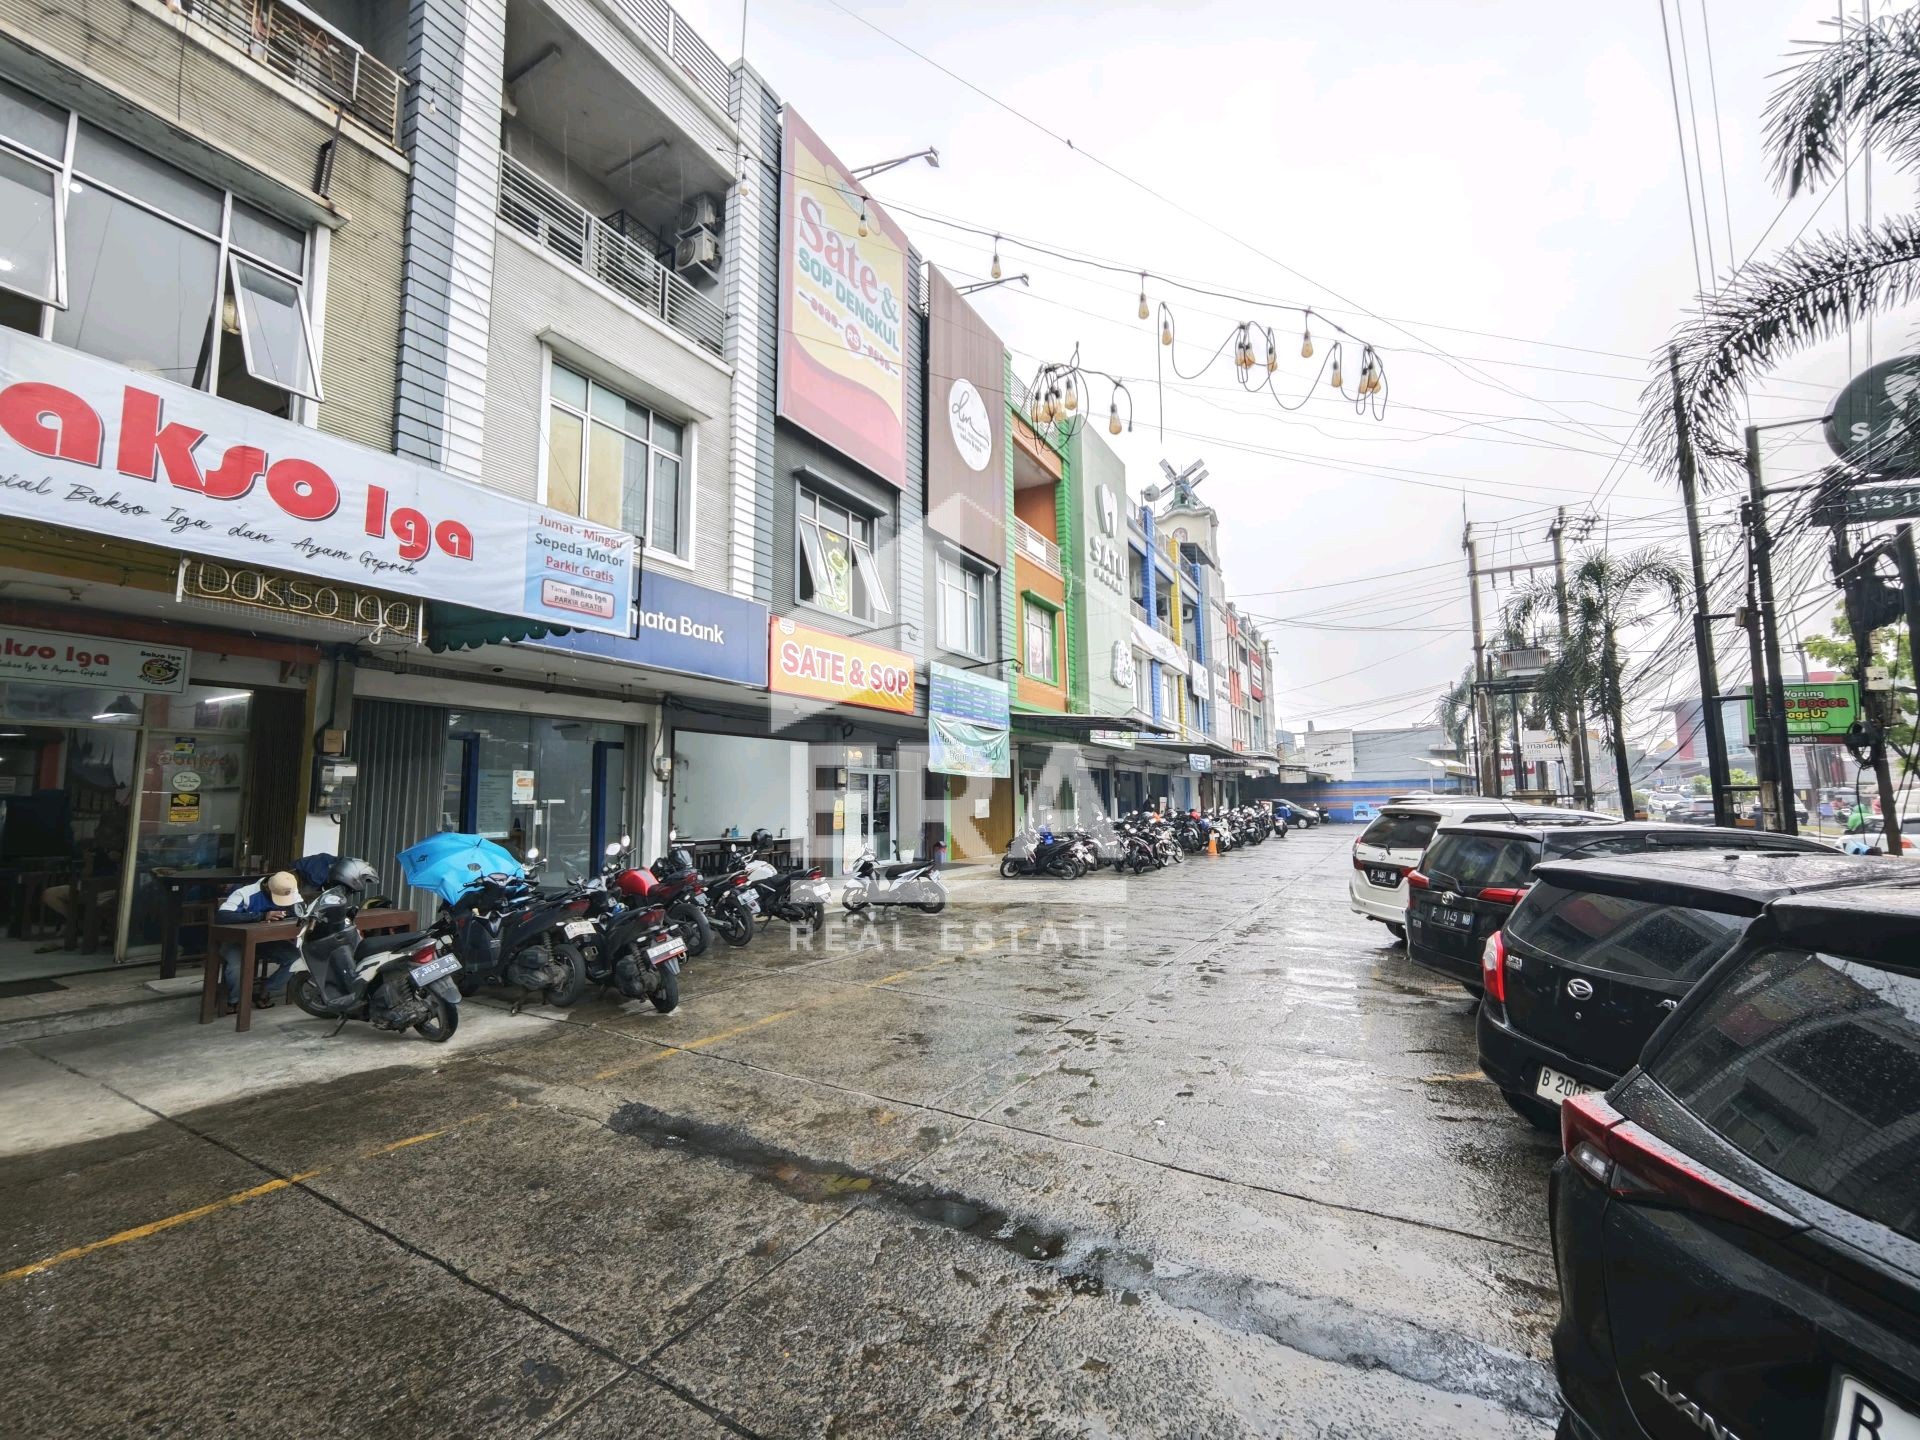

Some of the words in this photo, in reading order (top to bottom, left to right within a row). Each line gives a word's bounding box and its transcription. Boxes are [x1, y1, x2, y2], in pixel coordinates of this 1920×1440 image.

[800, 196, 877, 304] Sate
[881, 287, 899, 323] &
[799, 247, 832, 288] SOP
[836, 277, 900, 352] DENGKUL
[63, 483, 152, 516] Bakso
[161, 506, 213, 534] Iga
[227, 522, 275, 544] dan
[291, 536, 353, 559] Ayam
[359, 550, 419, 576] Geprek
[365, 484, 474, 562] Iga
[538, 514, 574, 535] Jumat
[583, 529, 624, 550] Minggu
[535, 532, 583, 557] Sepeda
[587, 547, 625, 568] Motor
[1090, 535, 1127, 580] SATU
[546, 554, 580, 574] Parkir
[582, 565, 614, 583] Gratis
[680, 615, 725, 645] Bank
[66, 646, 110, 668] Iga
[781, 641, 845, 685] SATE
[848, 657, 866, 688] &
[870, 663, 910, 697] SOP
[1786, 709, 1829, 721] ageUr
[1798, 698, 1849, 709] BOGOR
[1541, 1069, 1551, 1087] B
